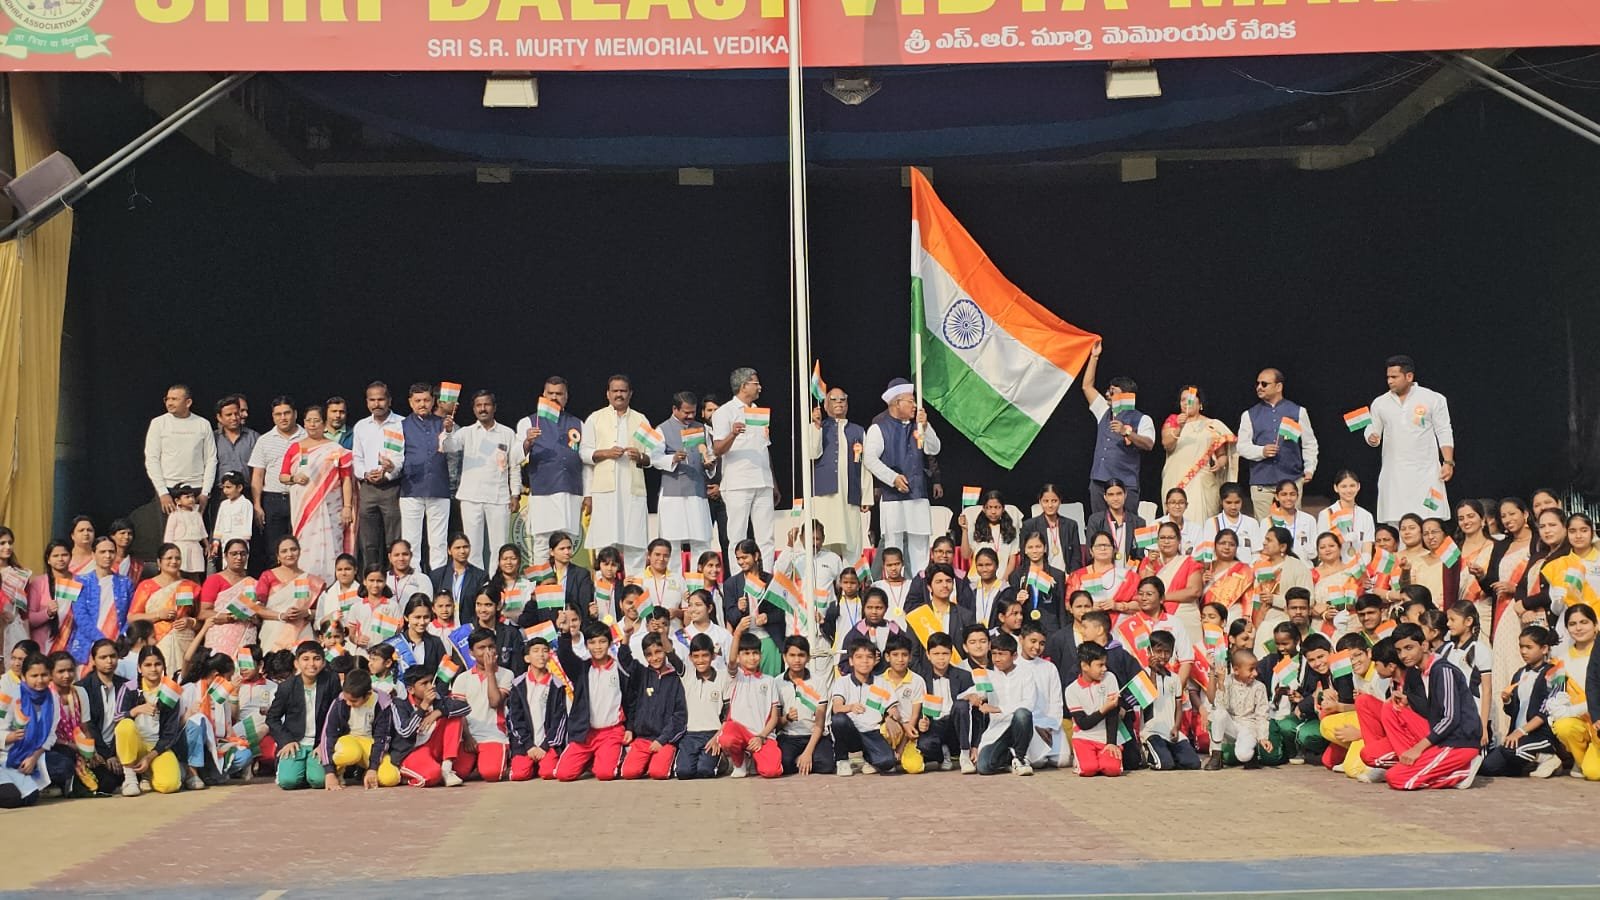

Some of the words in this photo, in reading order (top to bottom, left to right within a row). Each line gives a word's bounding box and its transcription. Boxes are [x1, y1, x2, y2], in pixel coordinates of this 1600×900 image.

[4, 0, 23, 19] DHRA
[23, 16, 78, 30] ASSOCIATION
[81, 0, 98, 17] RAIP
[427, 38, 462, 58] SRI
[469, 38, 509, 57] S.R.
[516, 38, 589, 57] MURTY
[594, 37, 709, 56] MEMORIAL
[713, 35, 788, 55] VEDIKA
[904, 28, 931, 54] శ్రీ
[936, 25, 1025, 49] ఎస్.ఆర్.
[1031, 27, 1094, 51] మూర్తి
[1240, 19, 1297, 41] వేదిక
